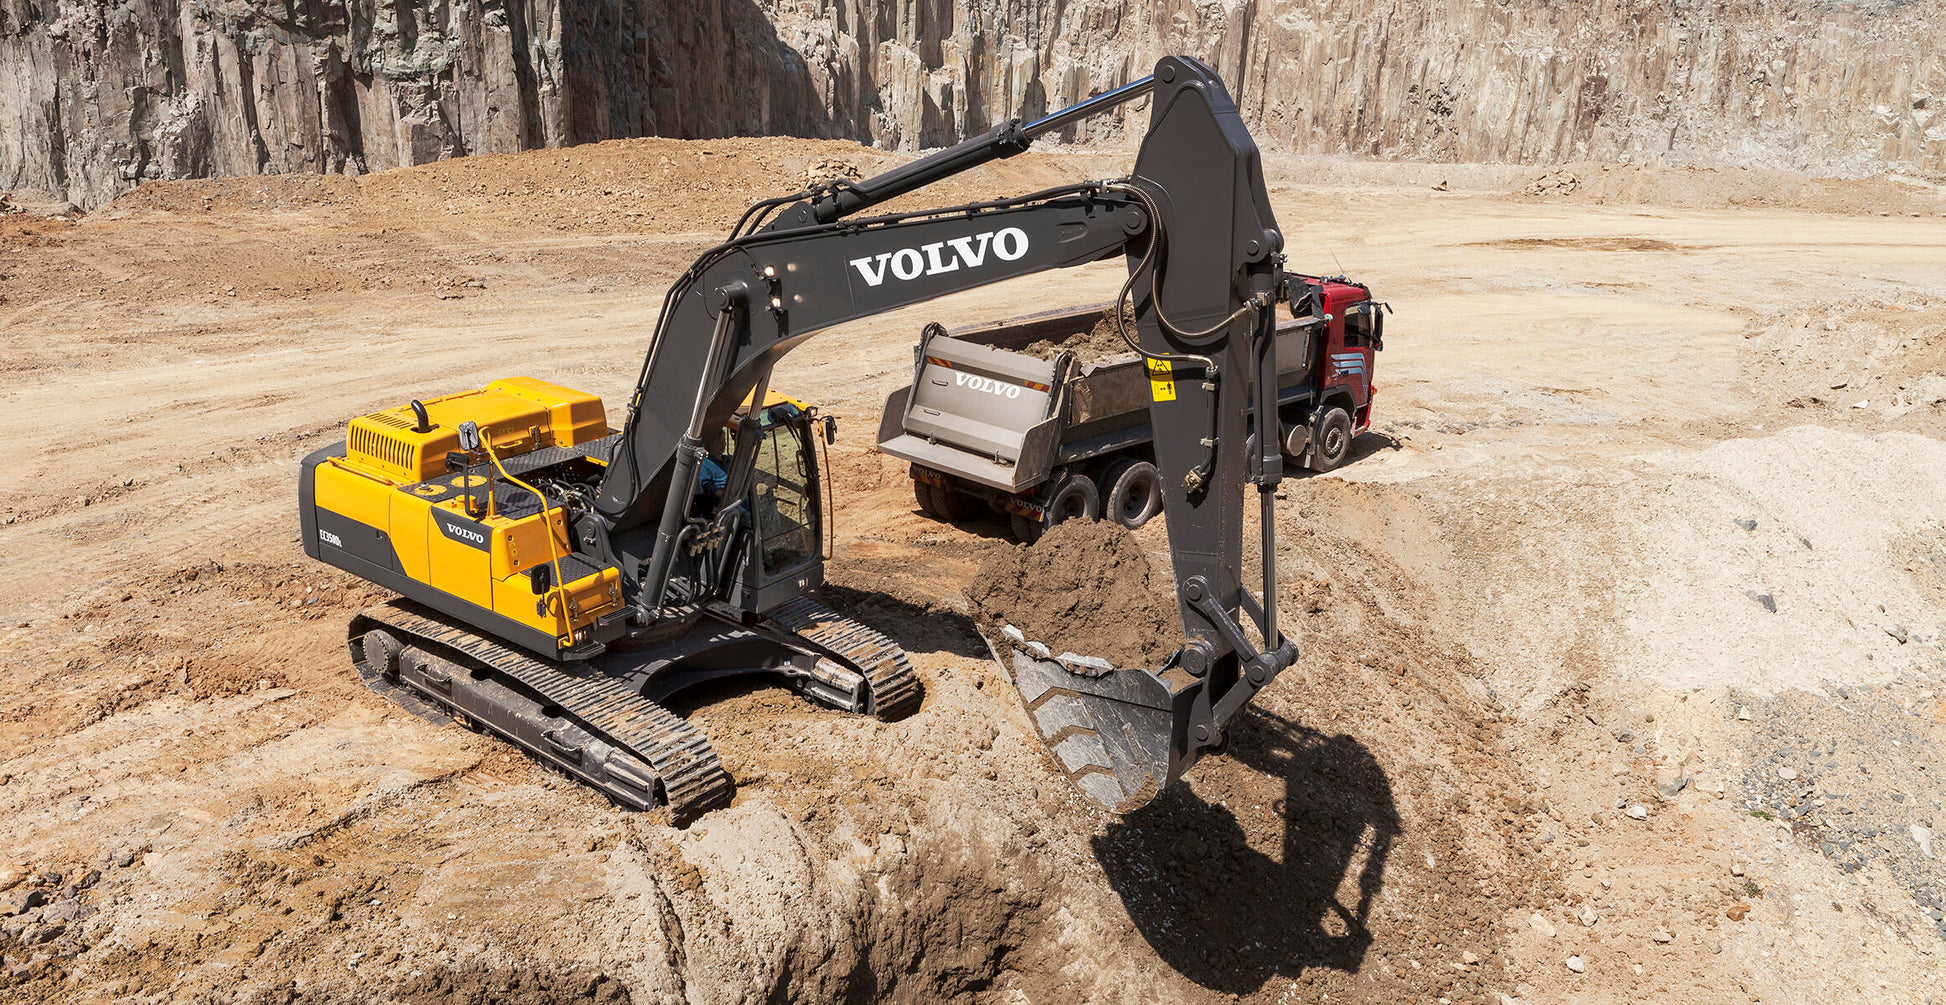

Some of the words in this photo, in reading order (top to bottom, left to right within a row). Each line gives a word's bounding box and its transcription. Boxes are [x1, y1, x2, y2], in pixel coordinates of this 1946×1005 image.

[849, 227, 1029, 287] VOLVO
[955, 372, 1021, 399] VOLVO
[1009, 498, 1042, 513] VOLVO
[446, 522, 484, 544] VOLVO
